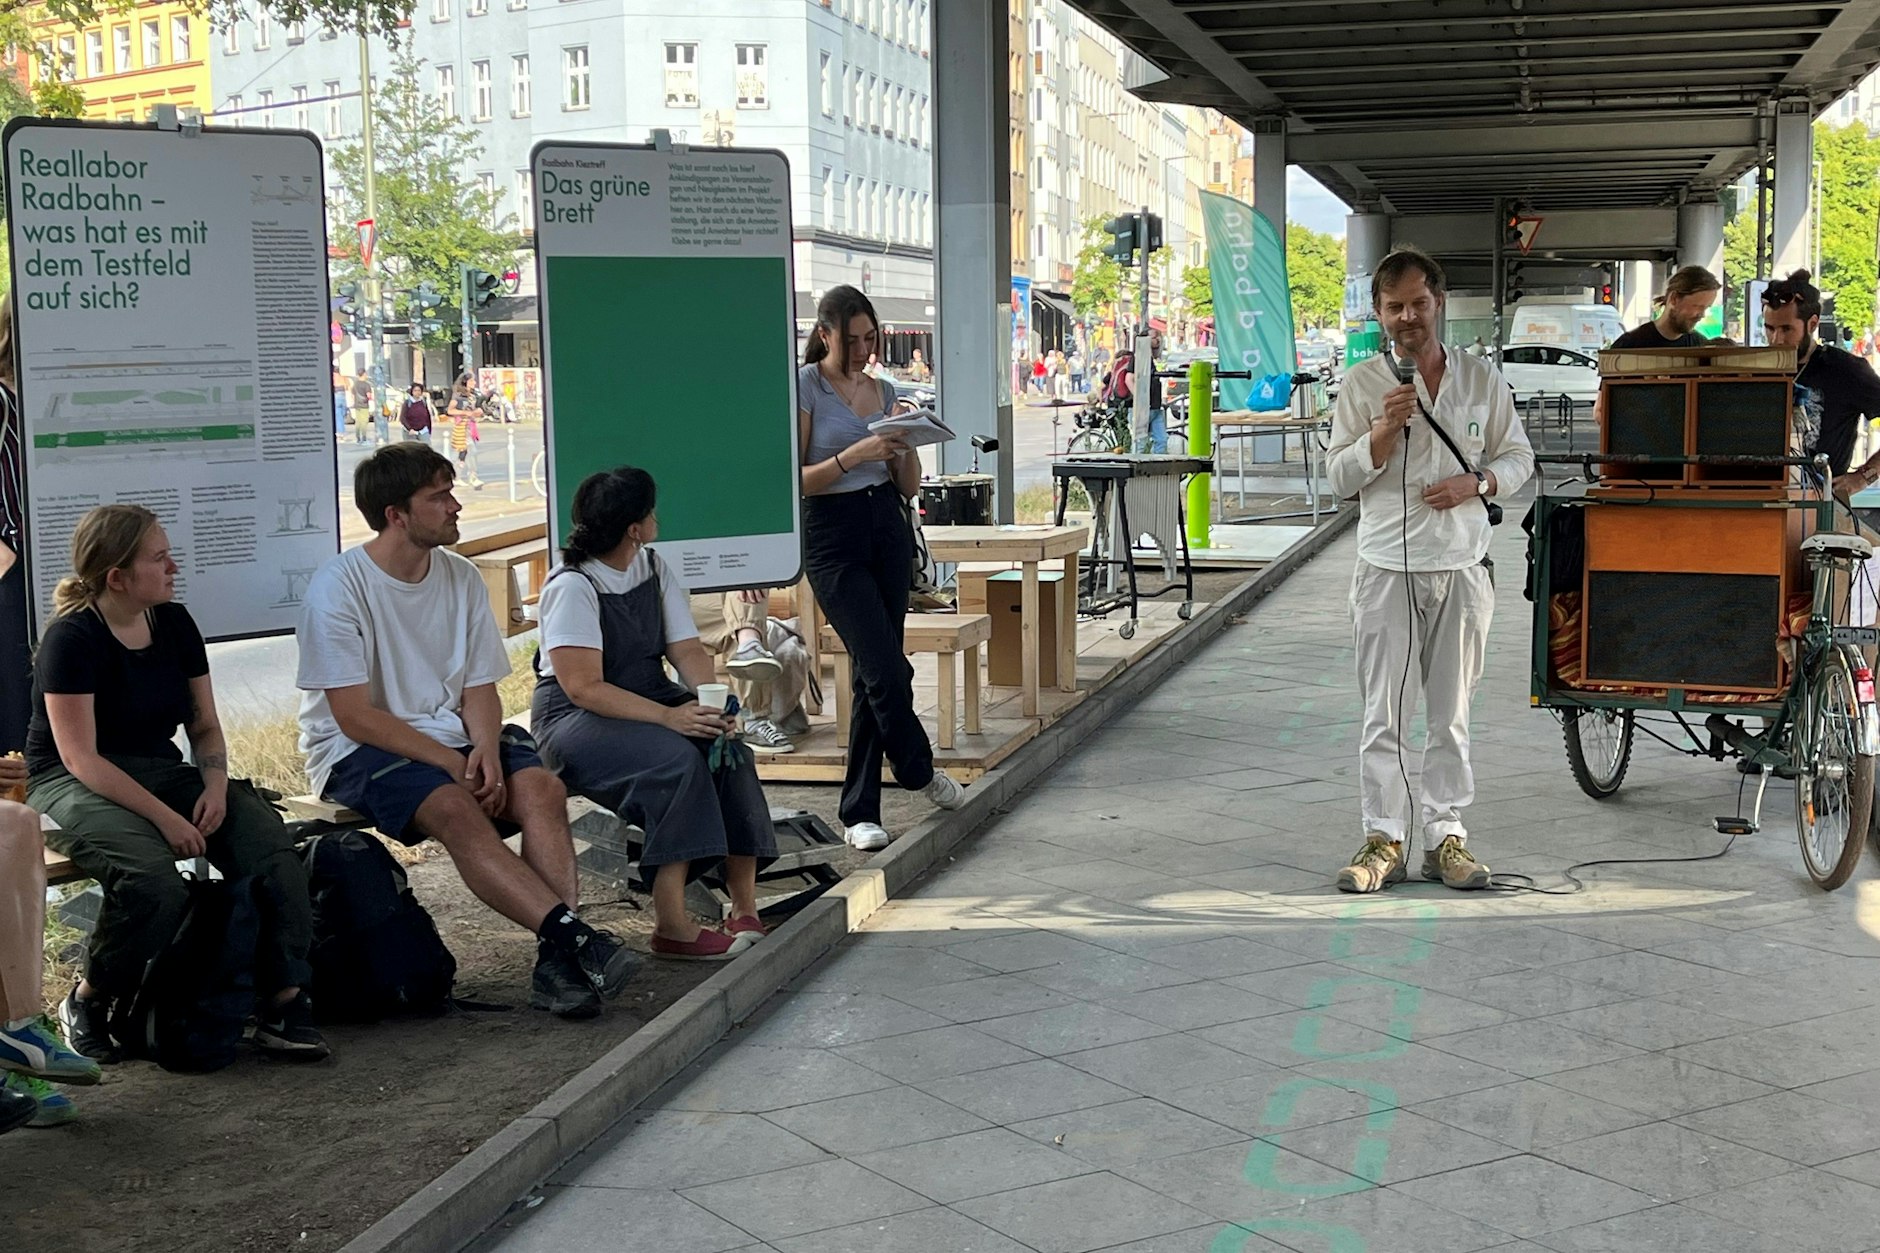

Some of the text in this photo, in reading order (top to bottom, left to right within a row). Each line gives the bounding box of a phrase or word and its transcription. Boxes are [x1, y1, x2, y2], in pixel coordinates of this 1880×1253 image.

[20, 148, 148, 179] Reallabor
[541, 158, 606, 169] Radbahn Kieztreff
[668, 163, 683, 172] Was
[21, 182, 142, 211] Radbahn
[541, 170, 650, 203] Das grüne
[748, 186, 770, 195] Projekt
[543, 199, 595, 224] Brett
[697, 206, 712, 214] Hast
[757, 196, 783, 204] Wochen
[22, 215, 208, 244] was hat es mit
[693, 226, 705, 235] und
[25, 248, 191, 277] dem Testfeld
[26, 282, 139, 310] auf sich?
